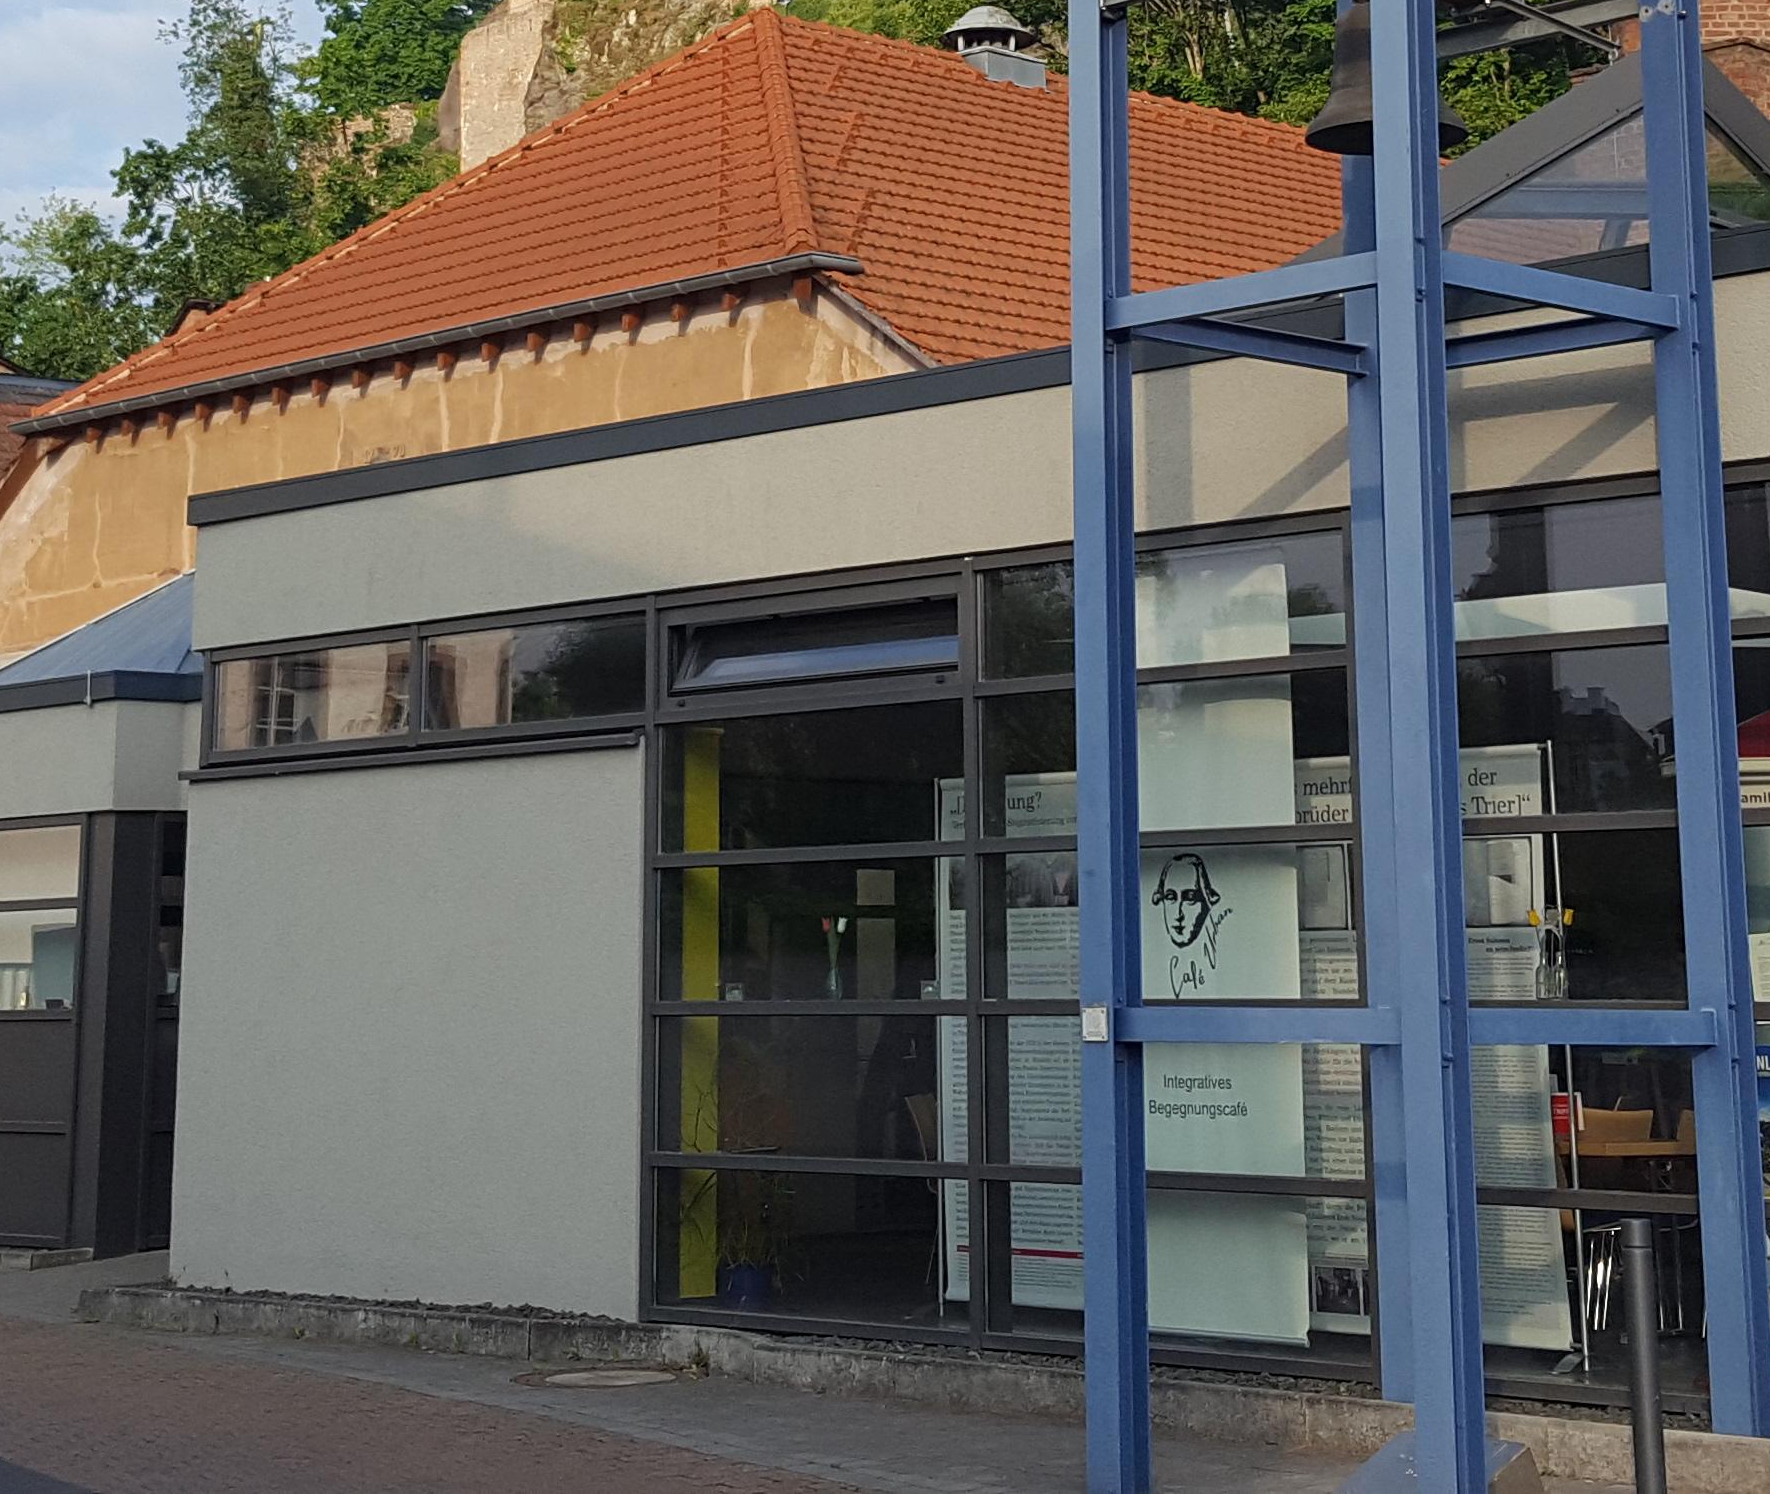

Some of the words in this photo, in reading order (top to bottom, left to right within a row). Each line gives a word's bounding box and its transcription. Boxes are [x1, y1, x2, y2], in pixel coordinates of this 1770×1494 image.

[1468, 767, 1498, 787] der
[1170, 955, 1205, 999] Café
[1163, 1074, 1232, 1093] Integratives
[1148, 1099, 1248, 1120] Begegnungscafé
